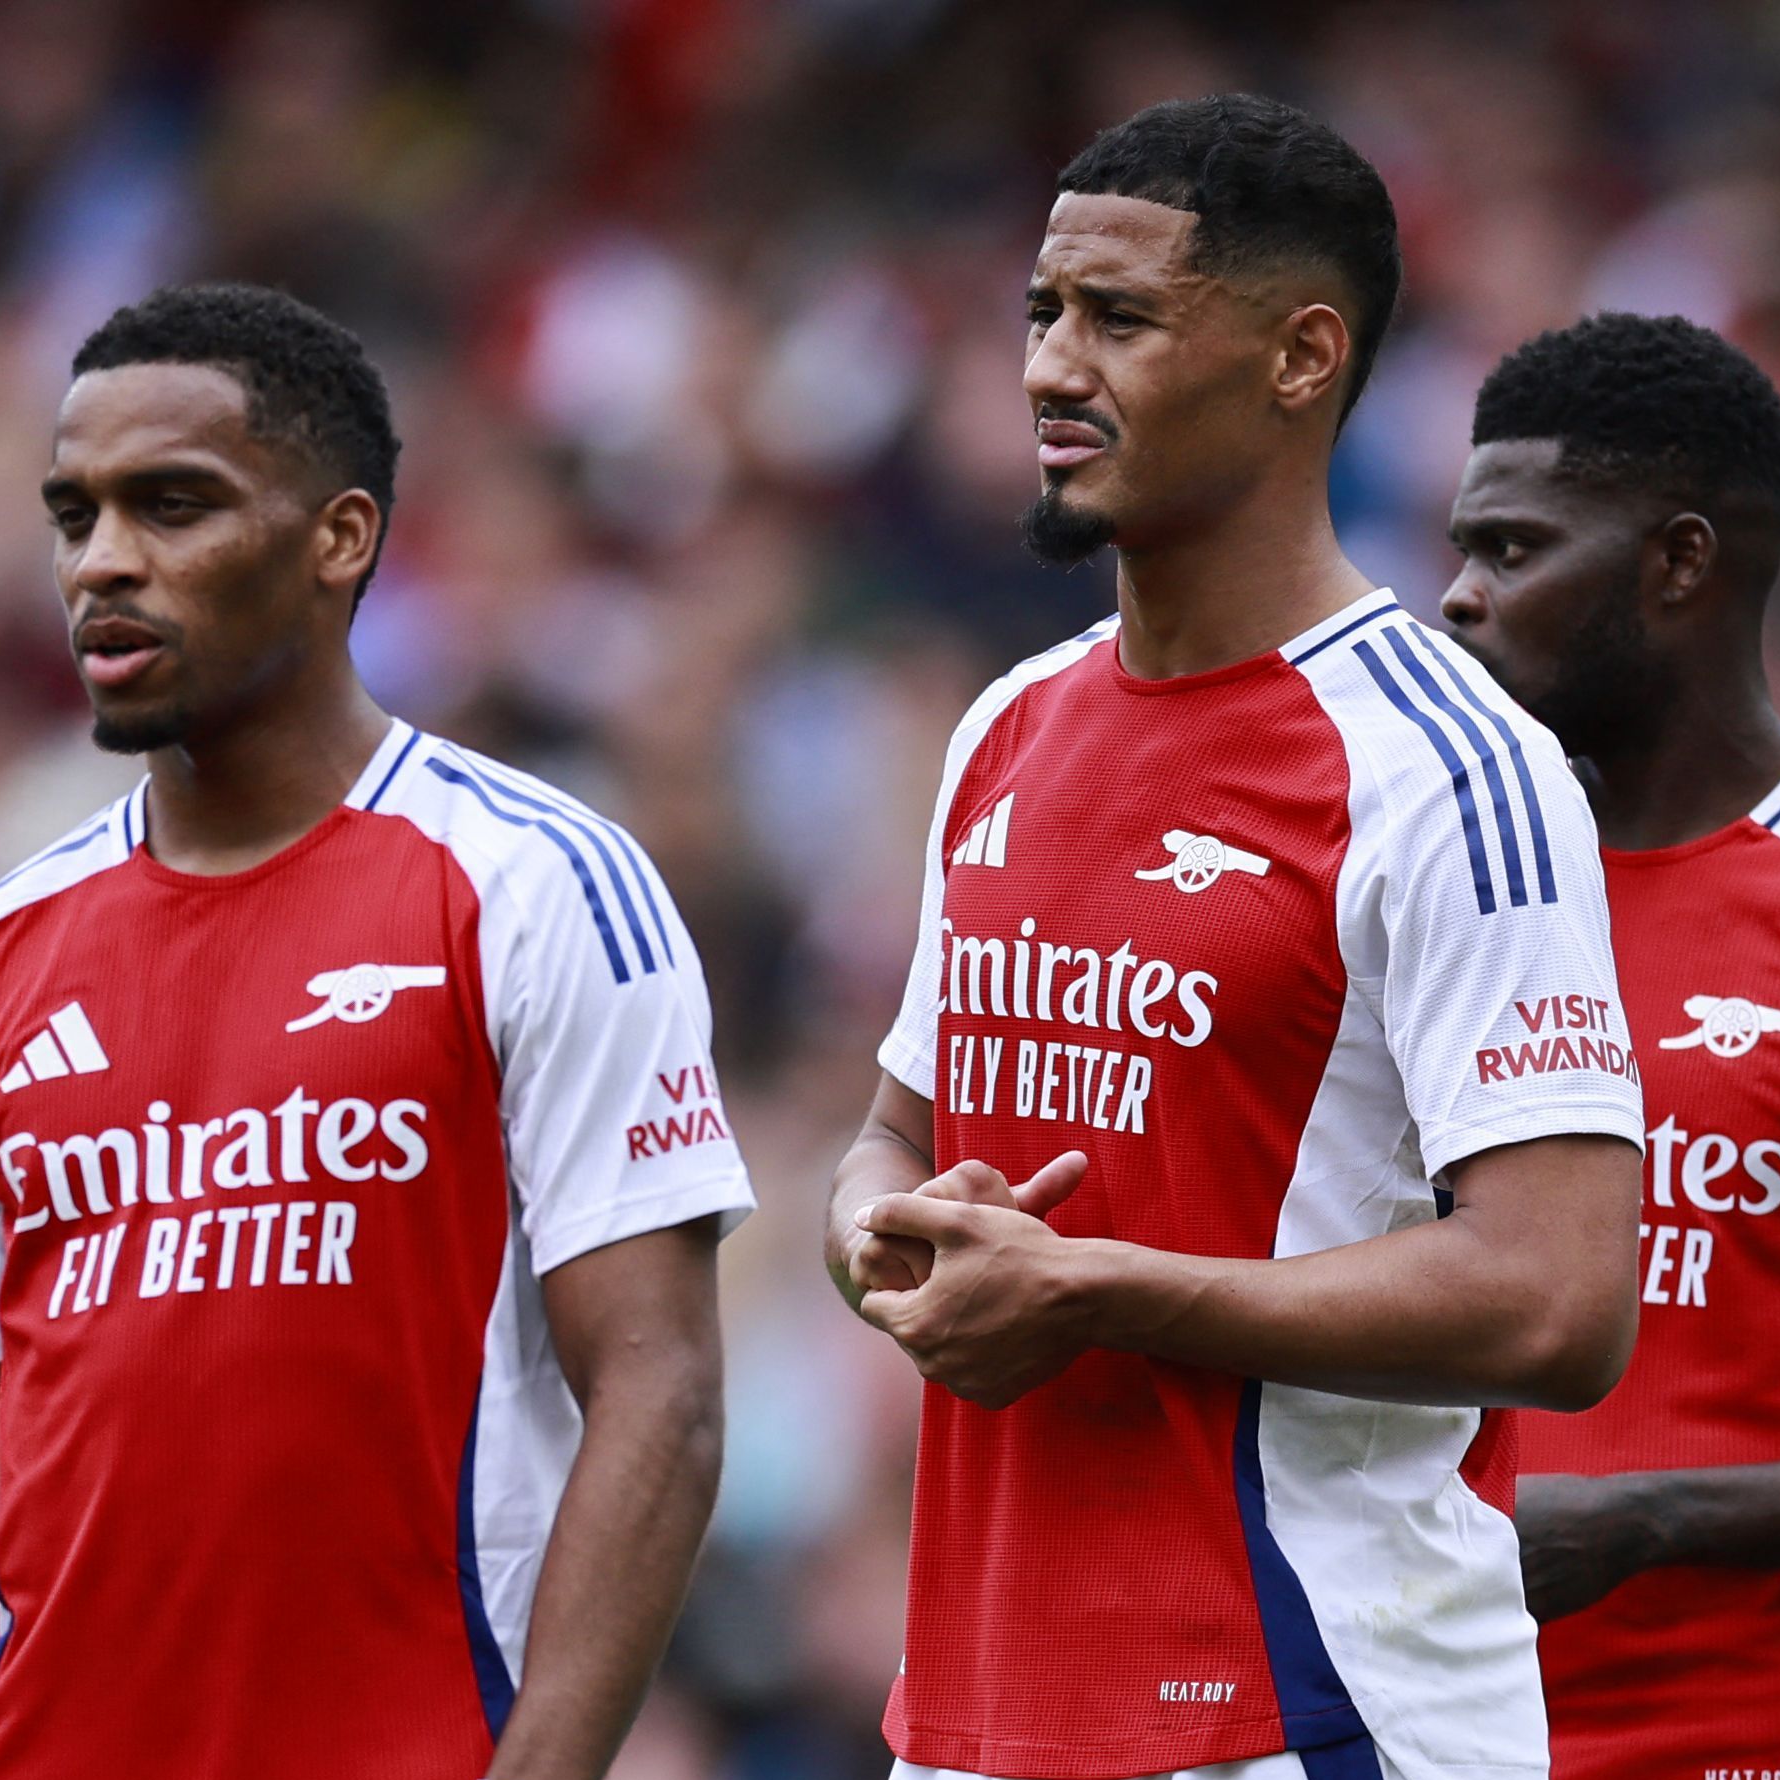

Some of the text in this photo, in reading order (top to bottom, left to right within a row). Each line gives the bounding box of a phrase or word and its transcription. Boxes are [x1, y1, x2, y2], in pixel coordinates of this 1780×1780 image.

[1514, 994, 1609, 1034] VISIT
[1476, 1036, 1639, 1087] RWANDA
[658, 1065, 718, 1105] VI
[949, 1035, 1152, 1135] FLY BETTER
[46, 1201, 357, 1319] FLY BETTER
[1159, 1680, 1236, 1703] HEAT.RDY
